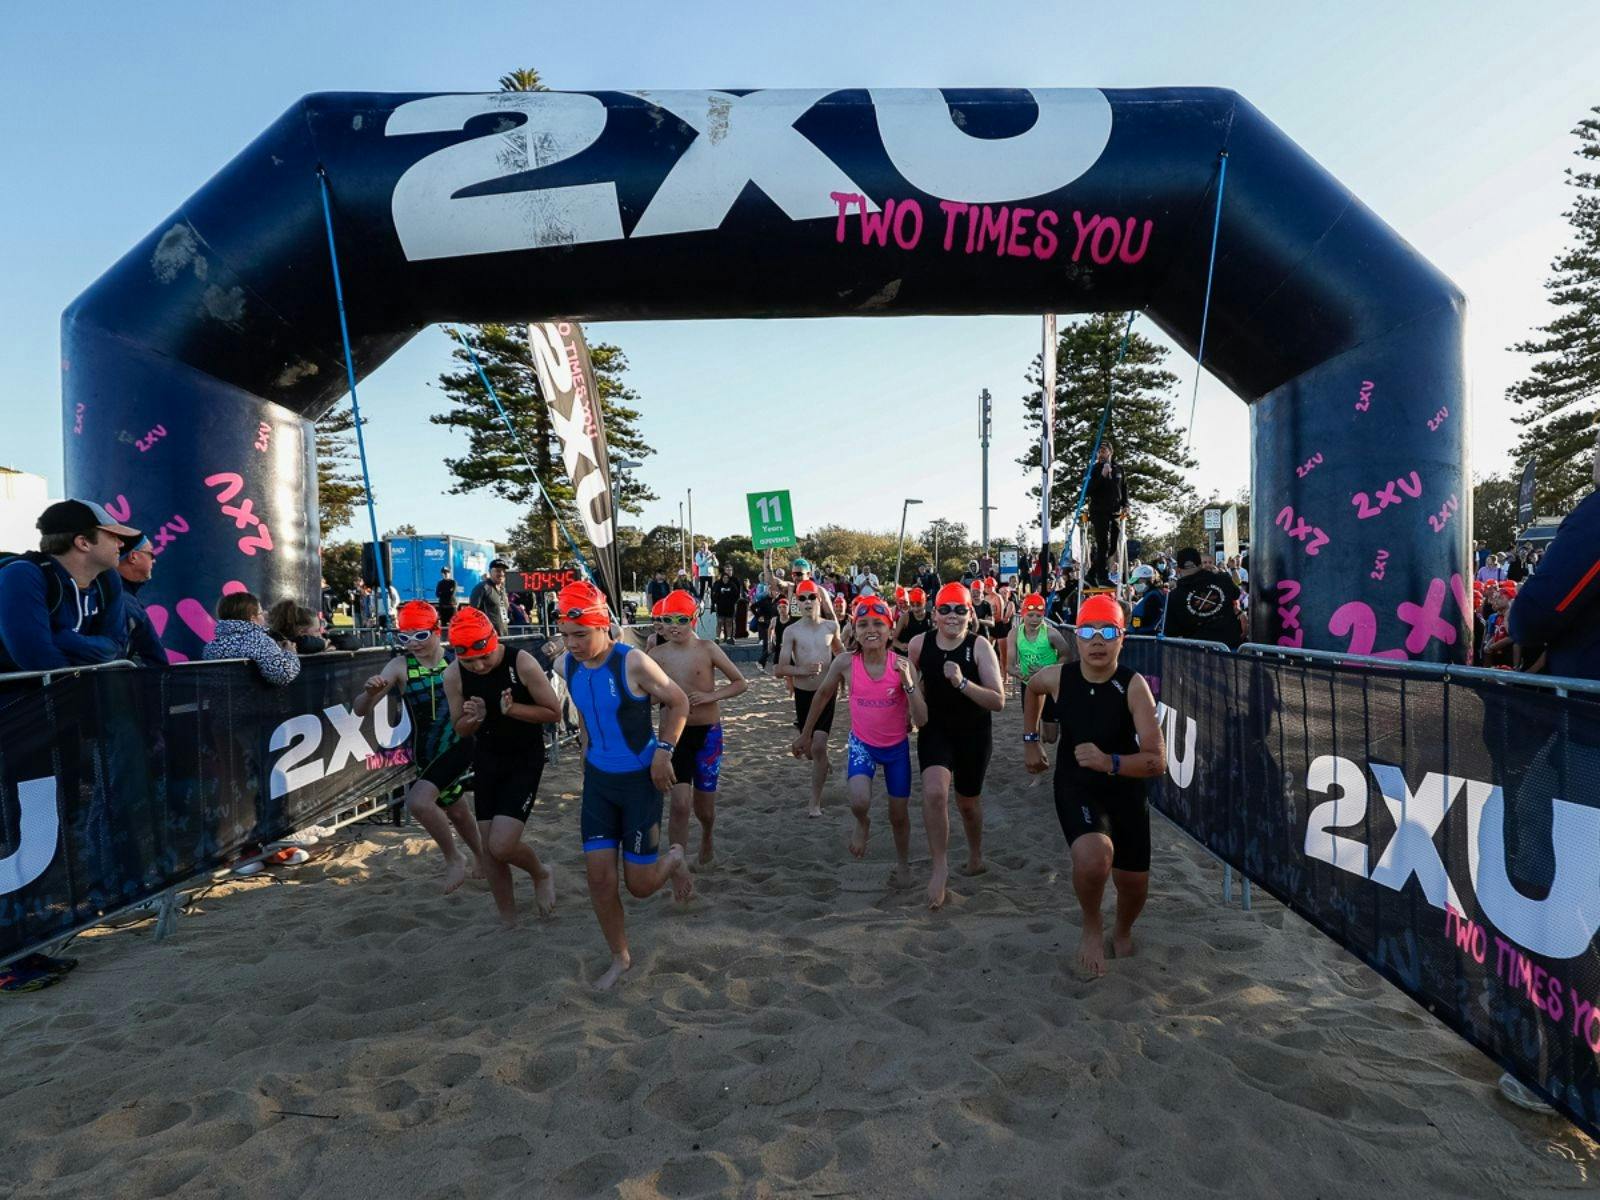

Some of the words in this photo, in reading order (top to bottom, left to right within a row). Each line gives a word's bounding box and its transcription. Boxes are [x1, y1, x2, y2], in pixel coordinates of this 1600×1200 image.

[384, 88, 1112, 262] 2XU
[830, 190, 924, 250] TWO
[940, 200, 1059, 261] TIMES
[1070, 211, 1154, 265] YOU
[565, 340, 587, 399] TIMES
[756, 495, 782, 523] 11
[519, 570, 574, 590] 7:04:45
[269, 695, 412, 800] 2XU
[1304, 755, 1600, 959] 2XU
[1445, 901, 1487, 964] TWO
[1495, 936, 1564, 1022] TIMES
